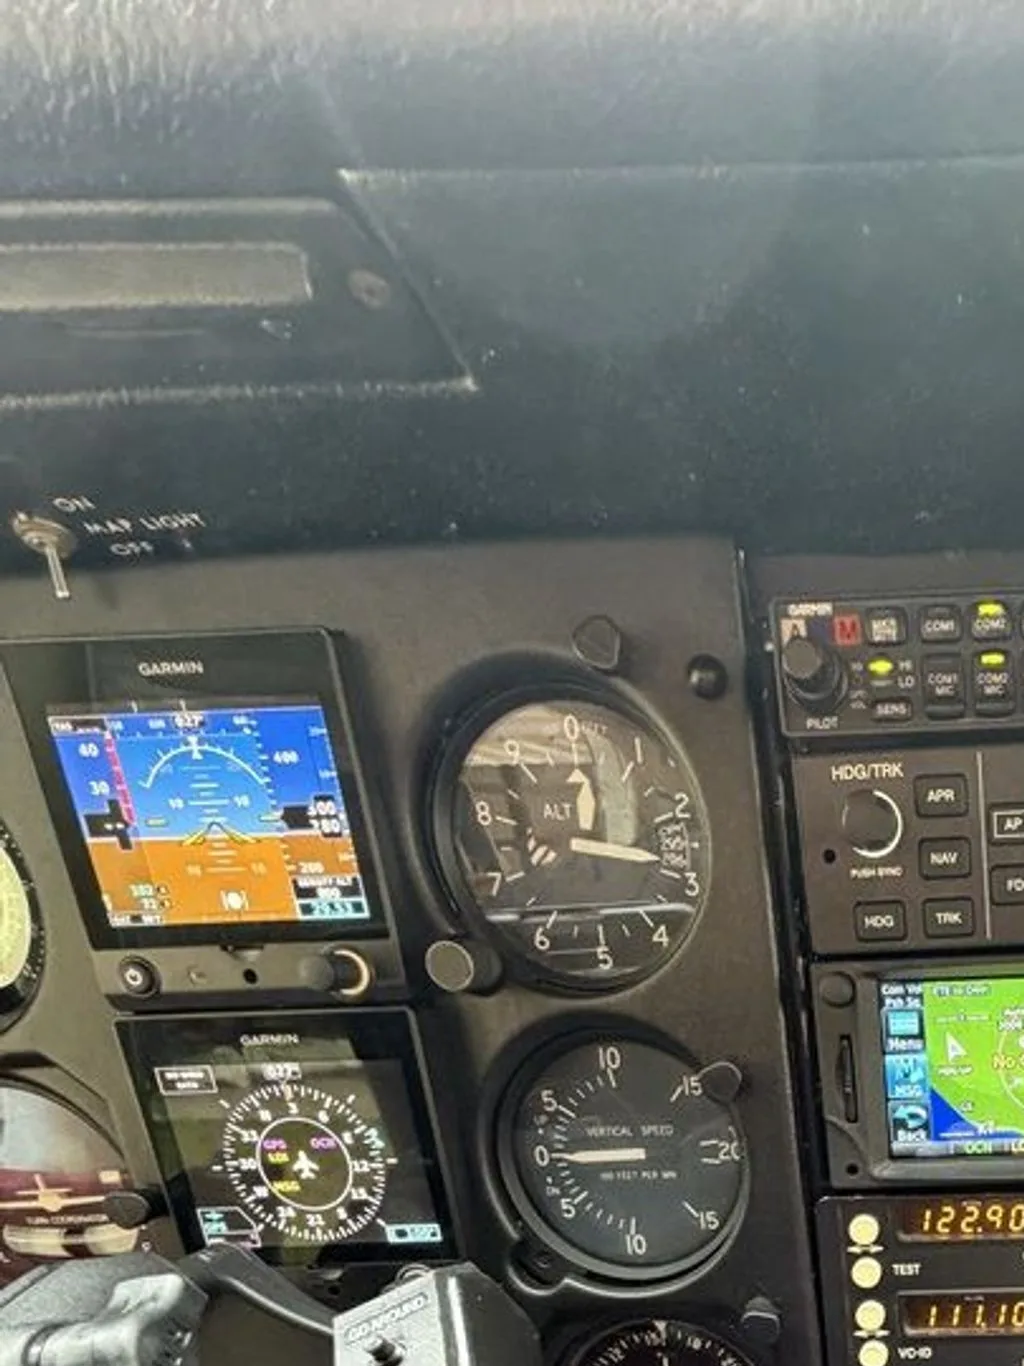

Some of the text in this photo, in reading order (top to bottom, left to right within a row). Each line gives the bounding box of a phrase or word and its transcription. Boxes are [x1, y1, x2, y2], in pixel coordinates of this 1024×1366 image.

[53, 496, 96, 513] ON
[85, 511, 206, 536] MAP LIGHT
[786, 602, 834, 617] GARMIN
[923, 620, 955, 633] COM1
[973, 617, 1006, 631] COM2
[138, 660, 205, 676] GARMIN
[875, 702, 908, 716] SENS
[562, 713, 580, 742] 0
[805, 715, 840, 730] PILOT
[503, 739, 520, 764] 9
[831, 762, 904, 781] HDG/TRK
[673, 792, 691, 819] 2
[927, 789, 955, 803] APR
[475, 800, 492, 826] 8
[542, 803, 571, 821] ALT
[1003, 817, 1024, 831] AP
[929, 851, 958, 865] NAV
[486, 871, 502, 897] 7
[684, 871, 700, 897] 3
[864, 914, 895, 928] HDG
[935, 912, 963, 924] TRK
[533, 926, 550, 950] 6
[652, 924, 669, 947] 4
[596, 945, 614, 971] 5
[240, 1034, 299, 1046] GARMIN
[598, 1046, 622, 1070] 10
[992, 1054, 1015, 1071] No
[681, 1075, 703, 1097] 15
[539, 1089, 558, 1113] 5
[585, 1123, 675, 1138] VERTICAL SPEED
[532, 1144, 550, 1168] 0
[559, 1198, 576, 1219] 5
[698, 1210, 720, 1231] 15
[624, 1234, 647, 1256] 10
[892, 1263, 922, 1276] TEST
